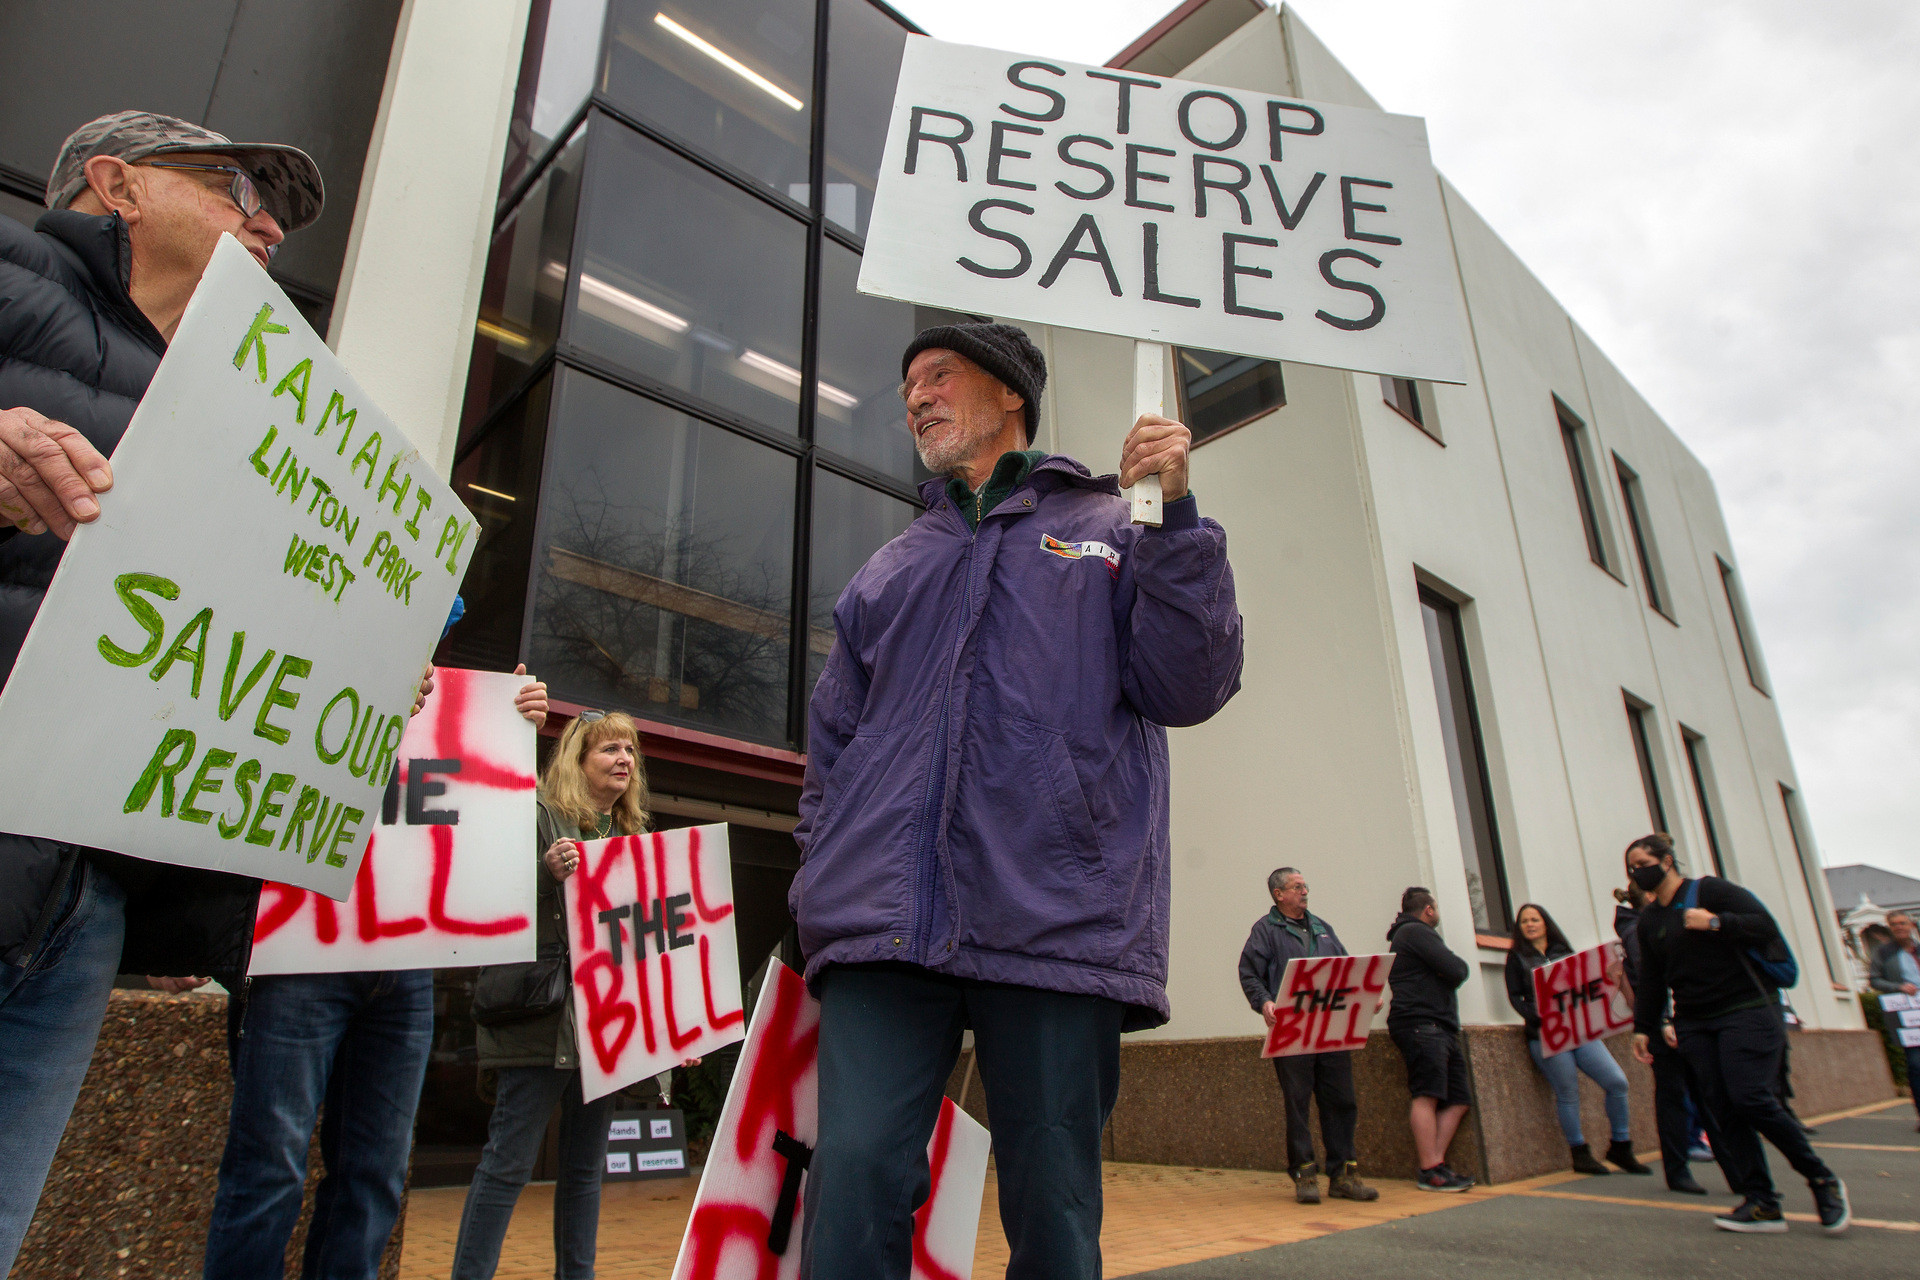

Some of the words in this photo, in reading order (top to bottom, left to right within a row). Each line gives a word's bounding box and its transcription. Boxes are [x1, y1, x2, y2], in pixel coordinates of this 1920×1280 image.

[1000, 61, 1325, 161] STOP
[904, 106, 1402, 245] RESERVE
[956, 199, 1386, 331] SALES
[233, 302, 434, 542] KAMAHI
[249, 425, 359, 545] LINTON
[362, 530, 423, 606] PARK
[284, 534, 356, 603] WEST
[97, 571, 313, 745] SAVE
[315, 686, 404, 787] OUR
[123, 728, 364, 869] RESERVE
[575, 827, 733, 951] KILL
[598, 892, 695, 966] THE
[574, 934, 744, 1074] BILL
[1289, 955, 1384, 999] KILL
[1292, 987, 1352, 1014] THE
[1534, 945, 1615, 1016] KILL
[1552, 977, 1604, 1013] THE
[1268, 1002, 1368, 1053] BILL
[1541, 993, 1634, 1052] BILL
[611, 1161, 626, 1169] our
[642, 1157, 678, 1167] reserves
[655, 1126, 667, 1135] off
